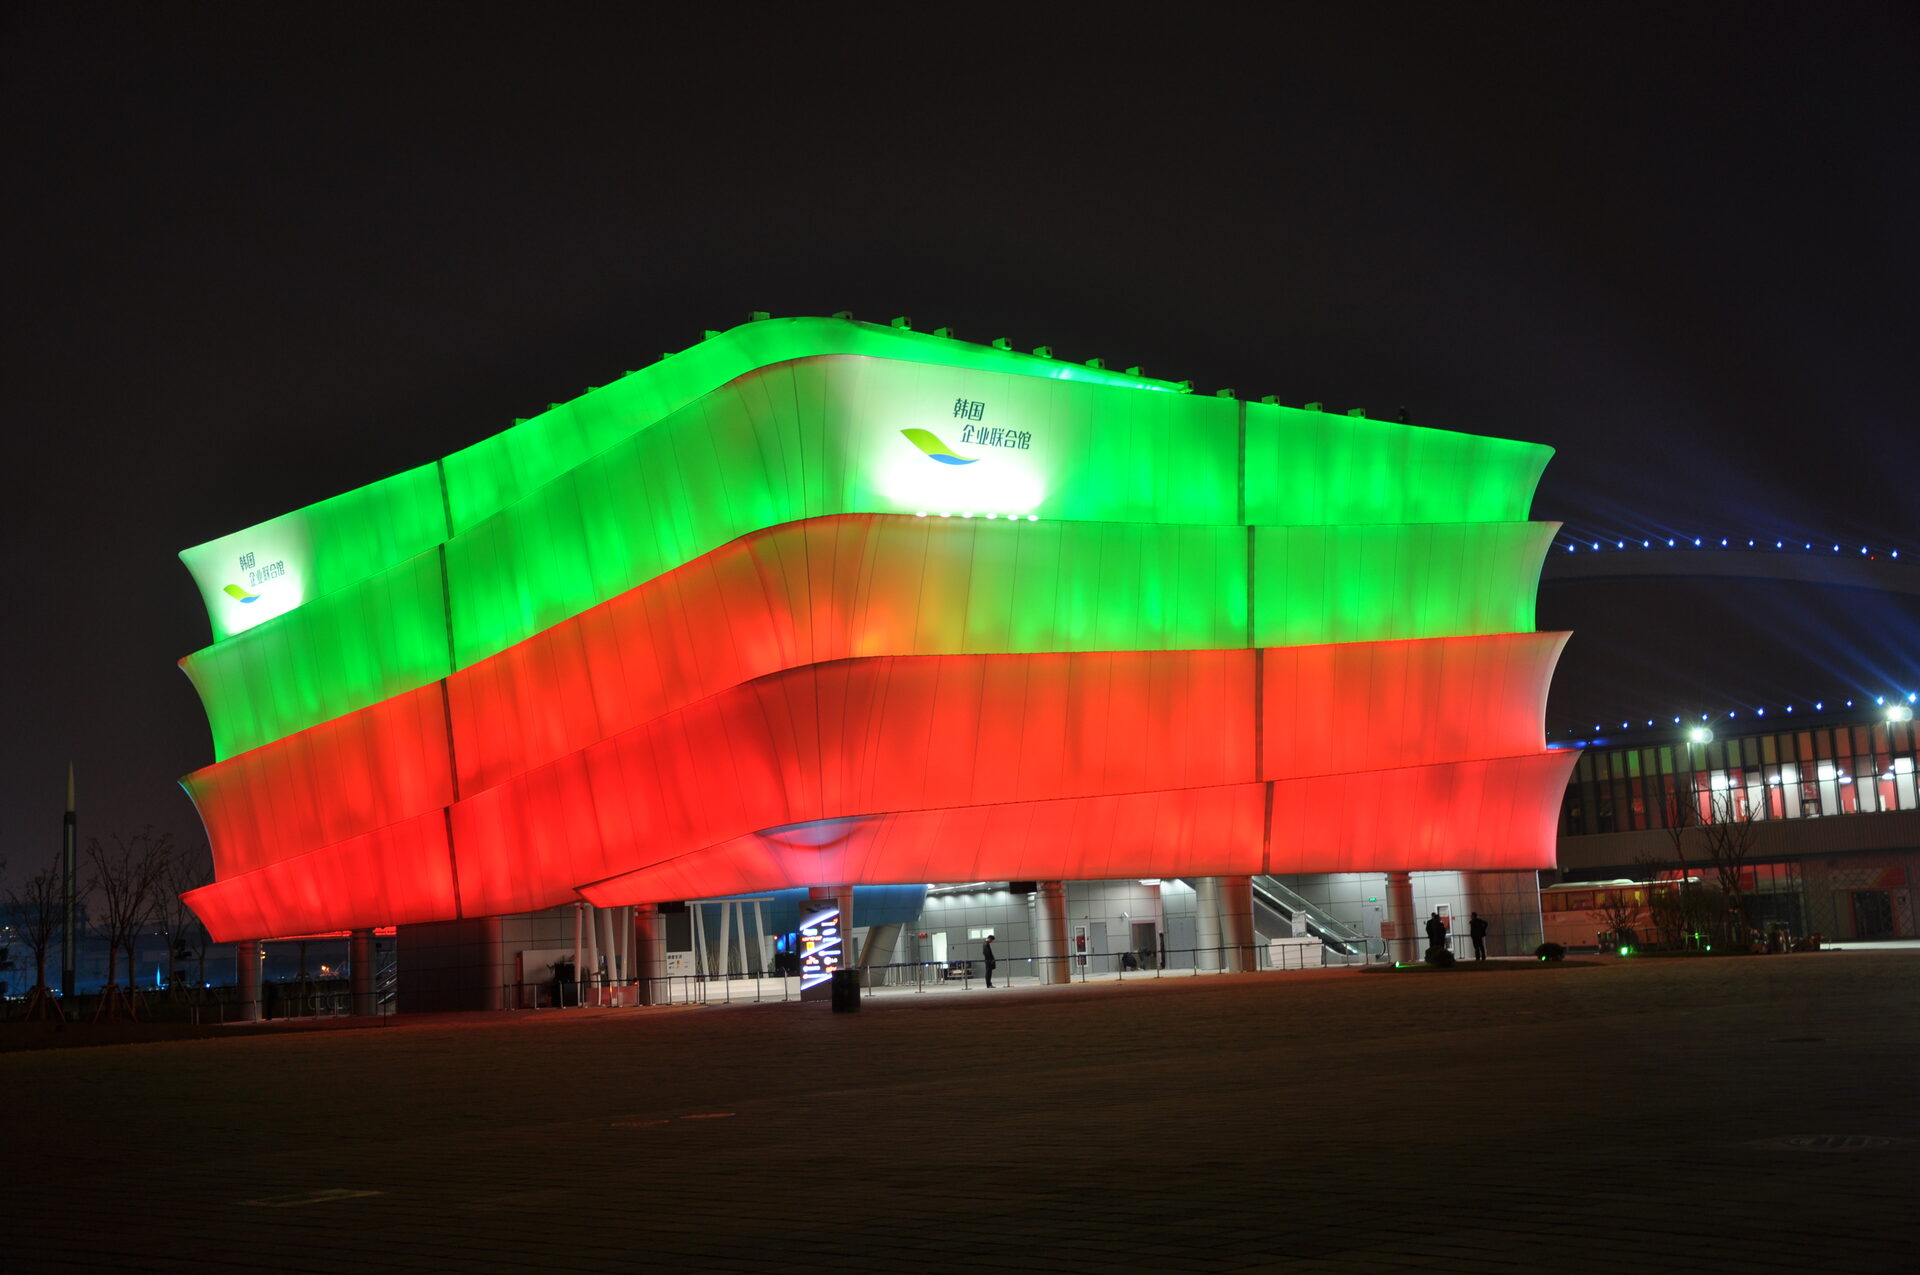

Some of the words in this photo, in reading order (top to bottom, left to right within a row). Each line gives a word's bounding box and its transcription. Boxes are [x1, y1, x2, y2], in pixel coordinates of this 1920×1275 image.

[953, 397, 985, 421] 韩国
[960, 424, 1032, 450] 企业联合馆
